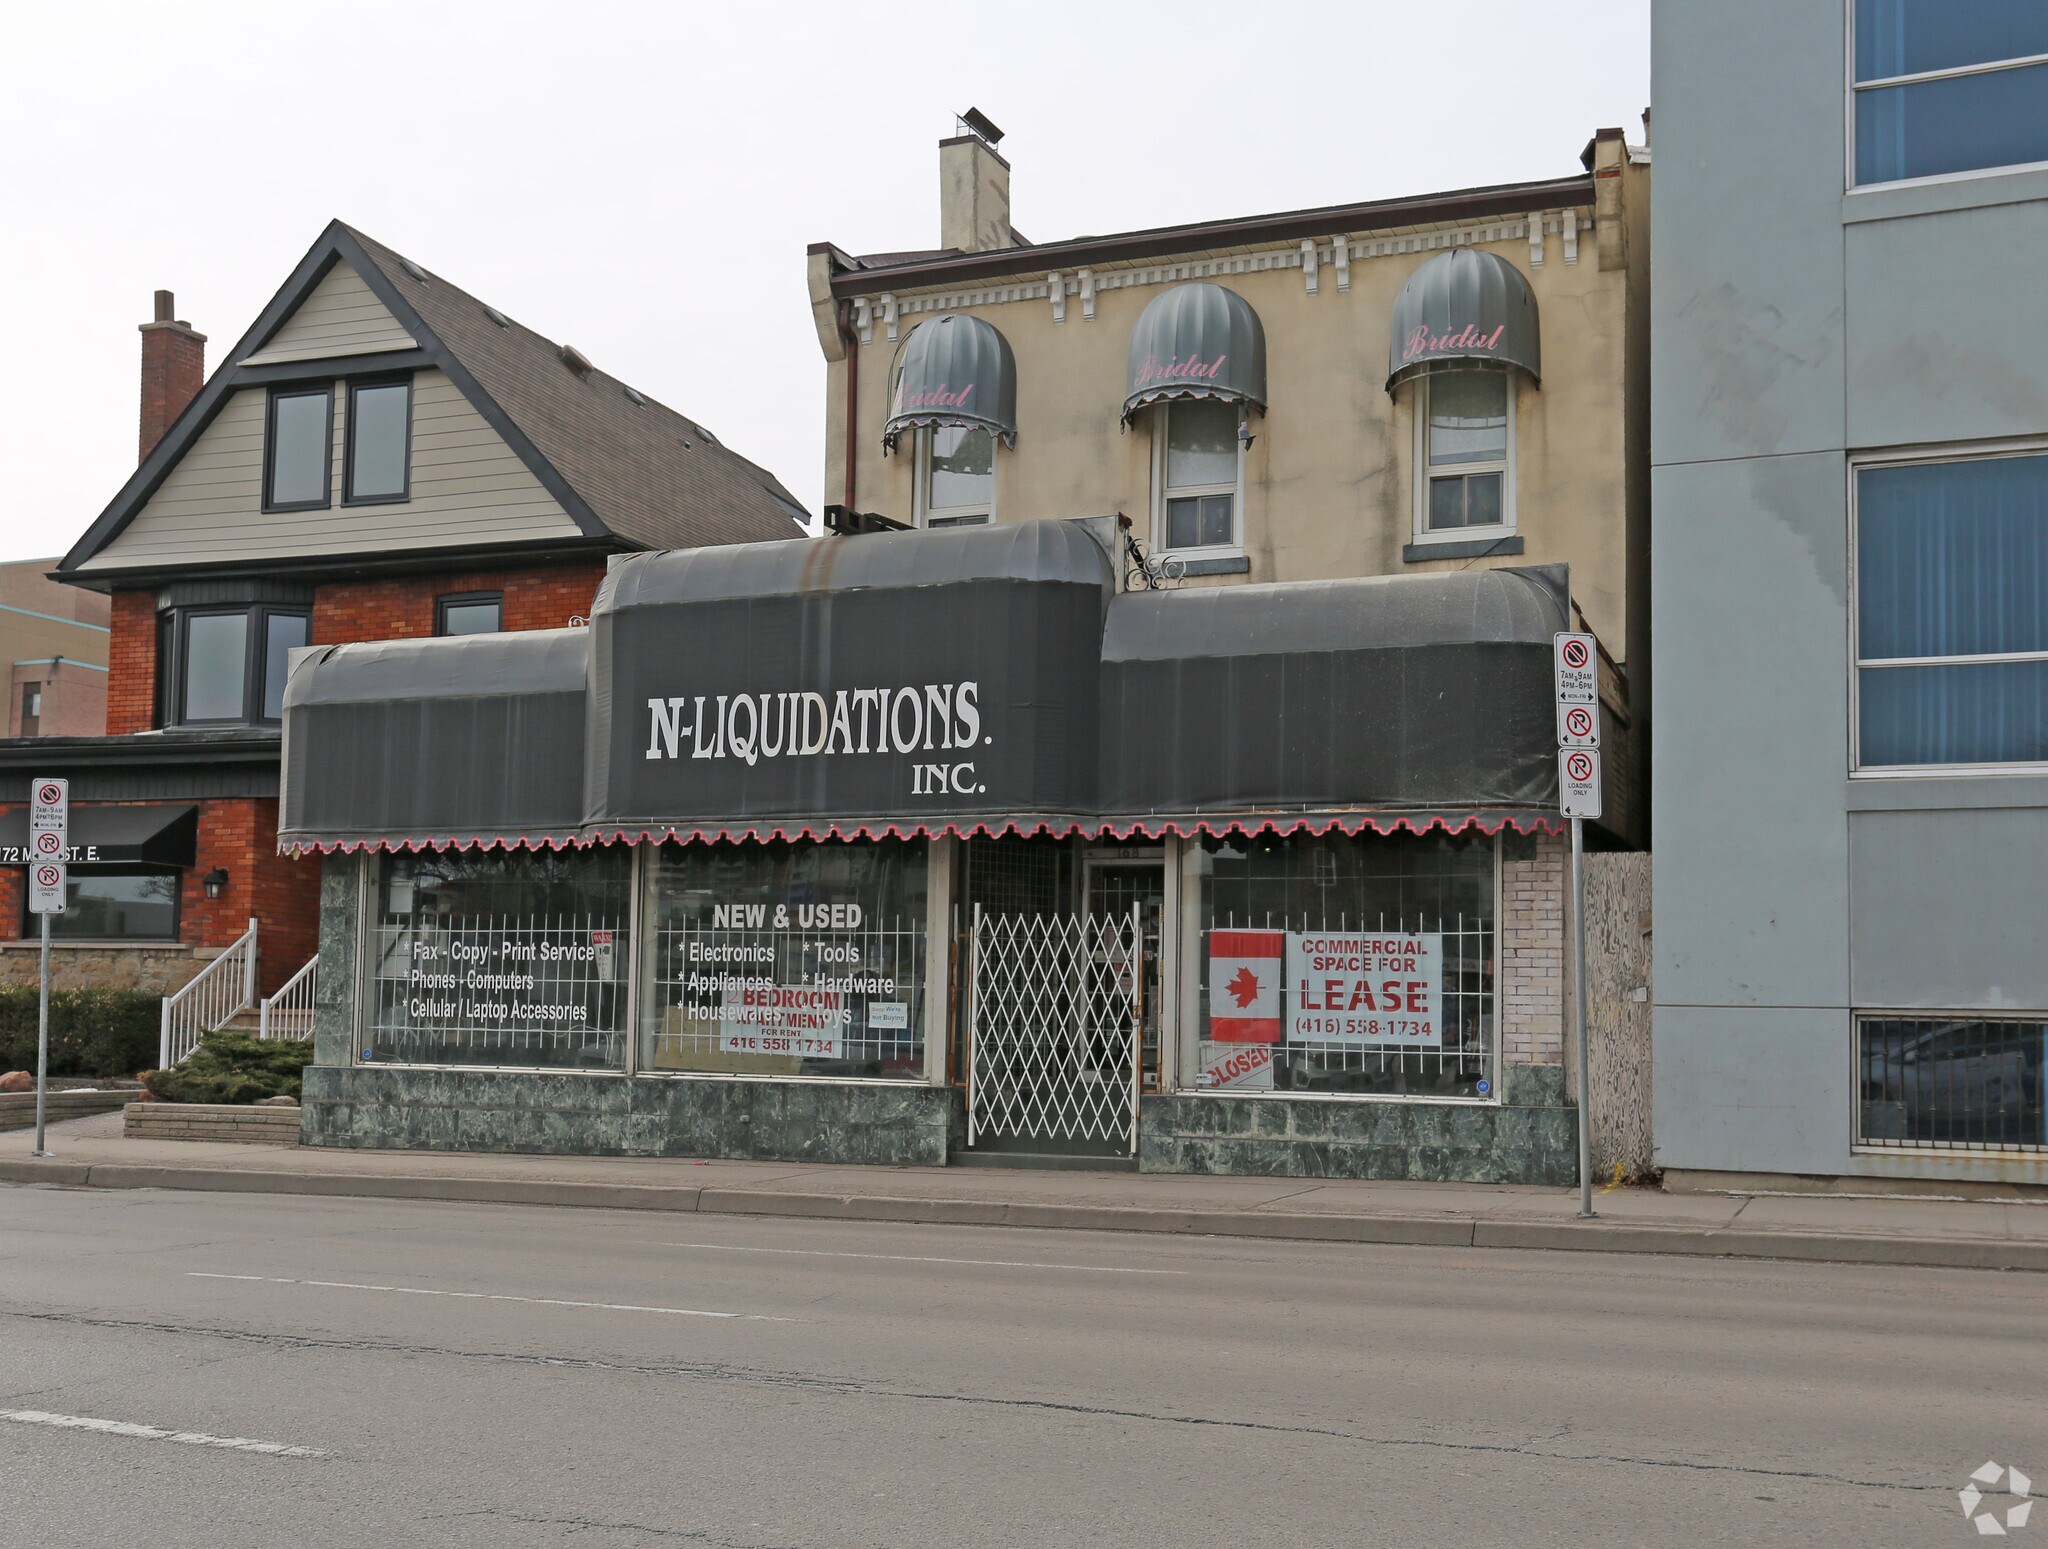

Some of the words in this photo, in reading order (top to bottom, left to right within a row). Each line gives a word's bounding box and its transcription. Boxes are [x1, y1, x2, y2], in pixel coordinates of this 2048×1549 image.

[1403, 324, 1505, 358] Bridal
[646, 681, 993, 766] N-LIQUIDATIONS.
[911, 762, 986, 794] INC.
[87, 846, 100, 861] E.
[714, 904, 766, 928] NEW
[773, 904, 790, 928] &
[799, 903, 862, 928] USED
[413, 942, 438, 960] Fax
[451, 941, 489, 965] Copy
[502, 942, 536, 961] Print
[540, 941, 595, 961] Service
[690, 942, 775, 962] Electronics
[815, 942, 860, 963] Tools
[1302, 939, 1428, 955] COMMERCIAL
[1313, 957, 1372, 971] SPACE
[1379, 957, 1416, 972] FOR
[411, 969, 456, 989] Phones
[467, 970, 534, 994] Computers
[688, 972, 773, 996] Appliances
[814, 973, 894, 994] Hardware
[743, 988, 839, 1009] BEDROOM
[1301, 979, 1429, 1013] LEASE
[410, 998, 456, 1018] Cellular
[466, 999, 508, 1023] Laptop
[511, 999, 587, 1021] Accessories
[688, 1001, 782, 1022] Housewares
[814, 1003, 852, 1030] Toys
[761, 1028, 777, 1036] FOR
[780, 1029, 801, 1037] RENT
[1296, 1017, 1341, 1035] (416)
[729, 1036, 756, 1049] 416
[762, 1038, 790, 1050] 558
[1206, 1045, 1272, 1088] CLOSED
